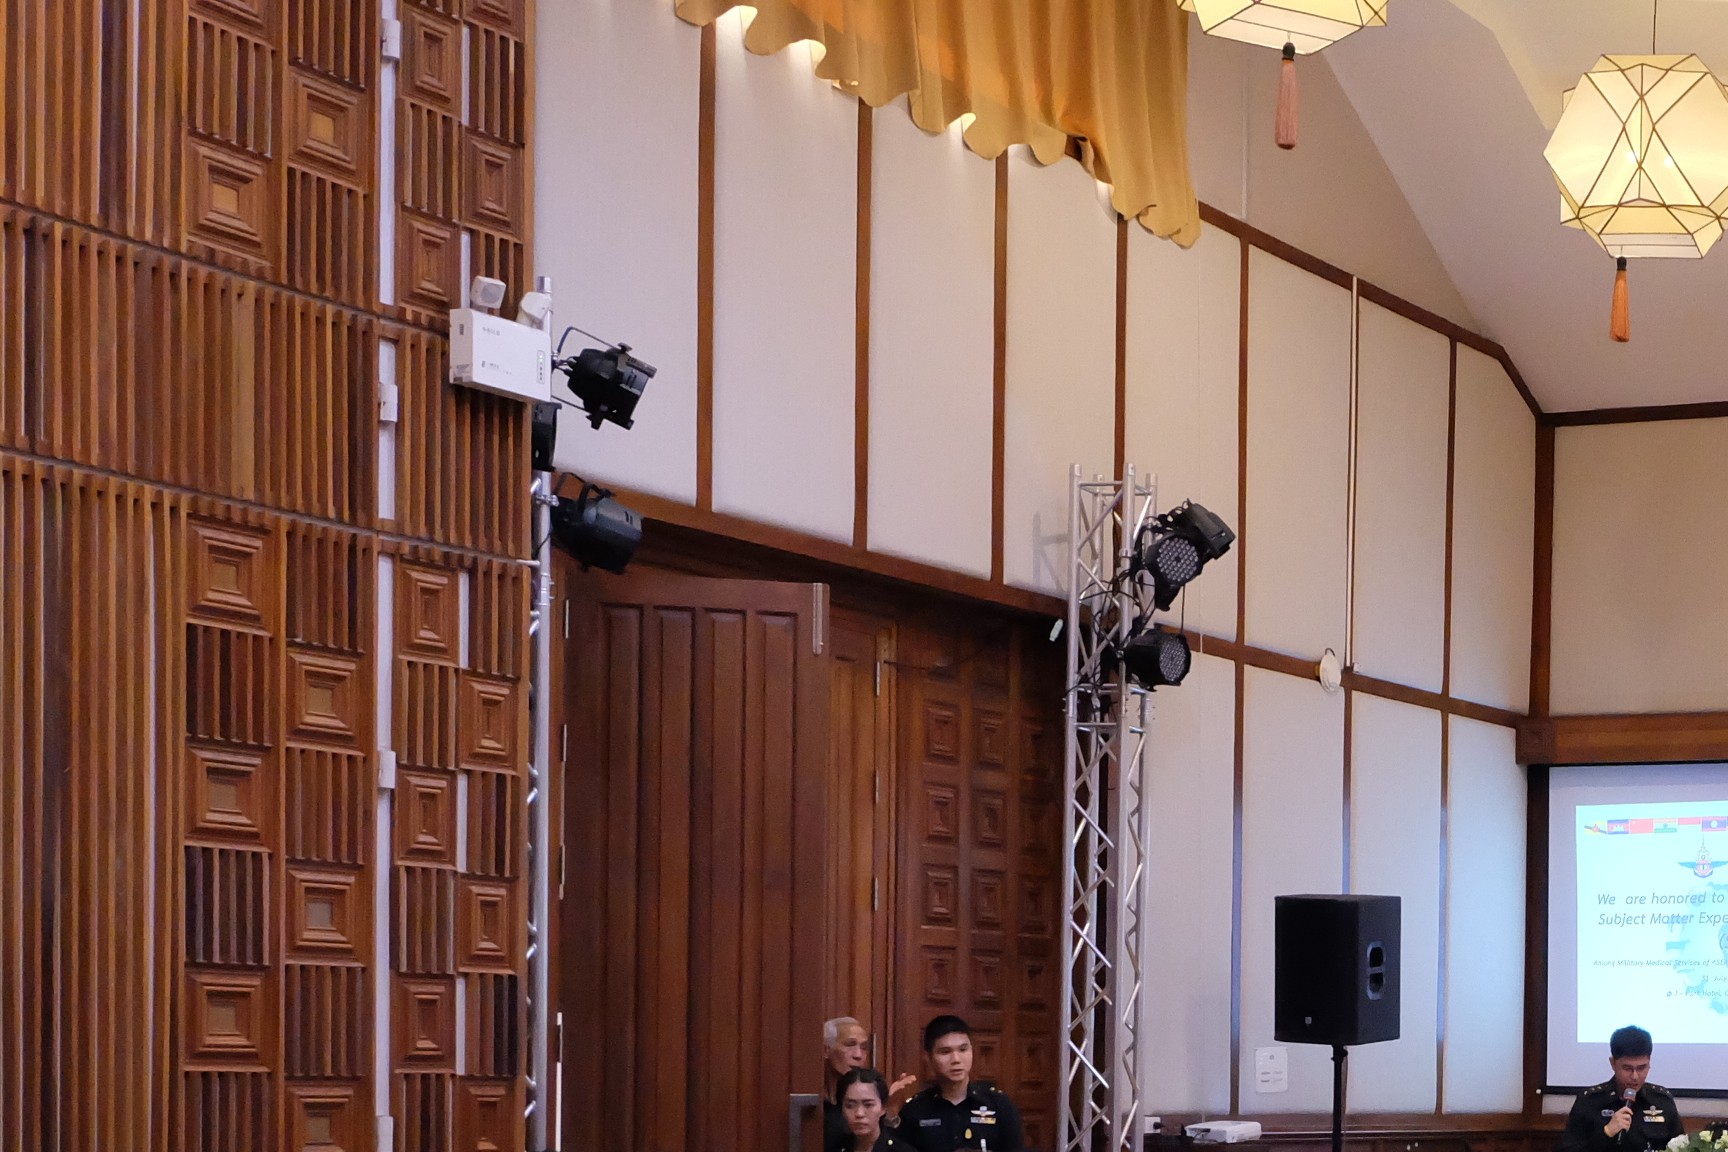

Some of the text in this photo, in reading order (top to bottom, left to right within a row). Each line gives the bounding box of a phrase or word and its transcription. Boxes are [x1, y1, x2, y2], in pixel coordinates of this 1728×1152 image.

[1597, 892, 1616, 905] We
[1625, 894, 1646, 905] are
[1651, 891, 1707, 905] honored
[1711, 892, 1726, 904] to
[1597, 912, 1645, 928] Subject
[1649, 912, 1695, 925] Matter
